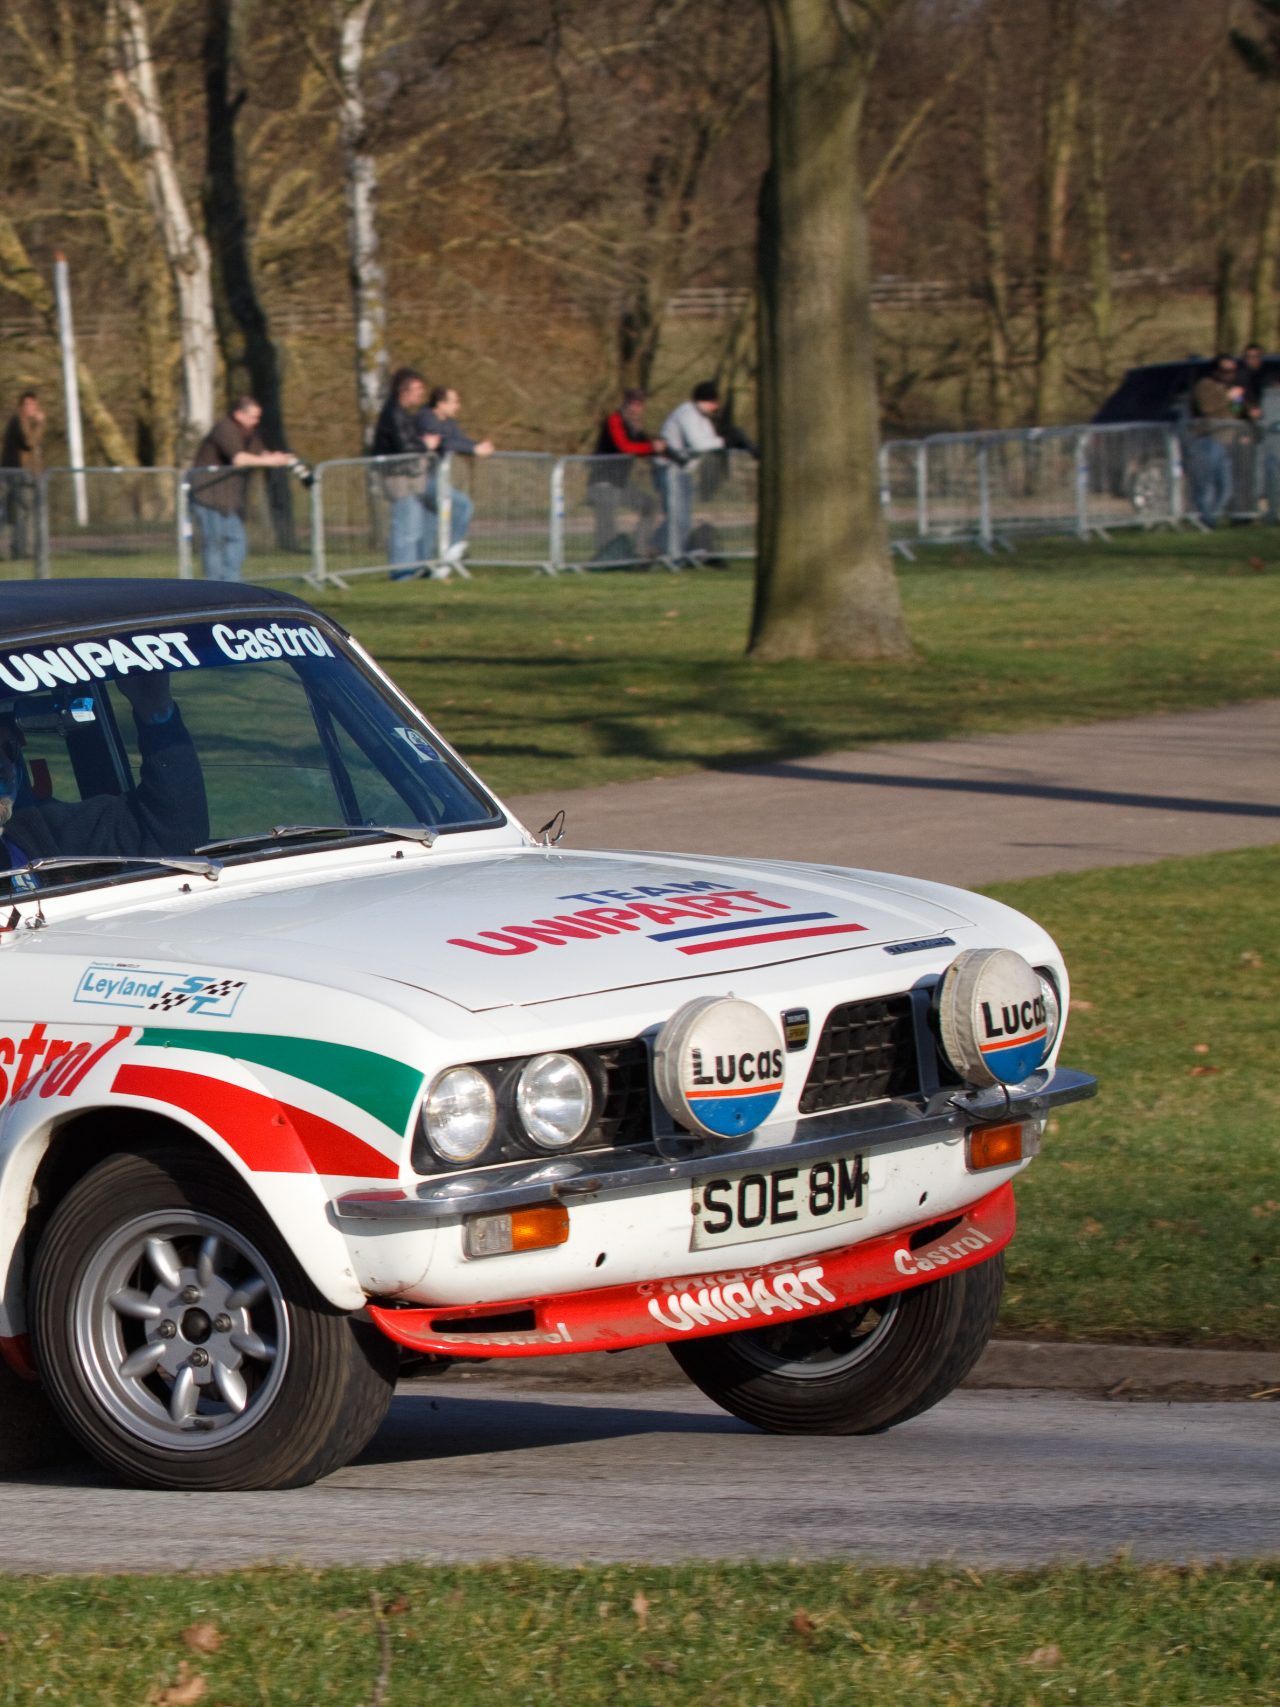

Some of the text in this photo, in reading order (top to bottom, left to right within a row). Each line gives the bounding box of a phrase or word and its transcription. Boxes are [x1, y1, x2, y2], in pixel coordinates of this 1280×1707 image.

[211, 623, 335, 661] Castrol
[557, 880, 737, 905] TEAM
[446, 890, 792, 956] UNIPART
[82, 972, 164, 999] Leyland
[980, 992, 1048, 1040] Lucas
[691, 1047, 783, 1086] Lucas
[703, 1153, 864, 1235] SOE 8M
[893, 1227, 993, 1276] Castrol
[647, 1266, 836, 1331] UNIPART
[441, 1323, 573, 1346] Castrol
